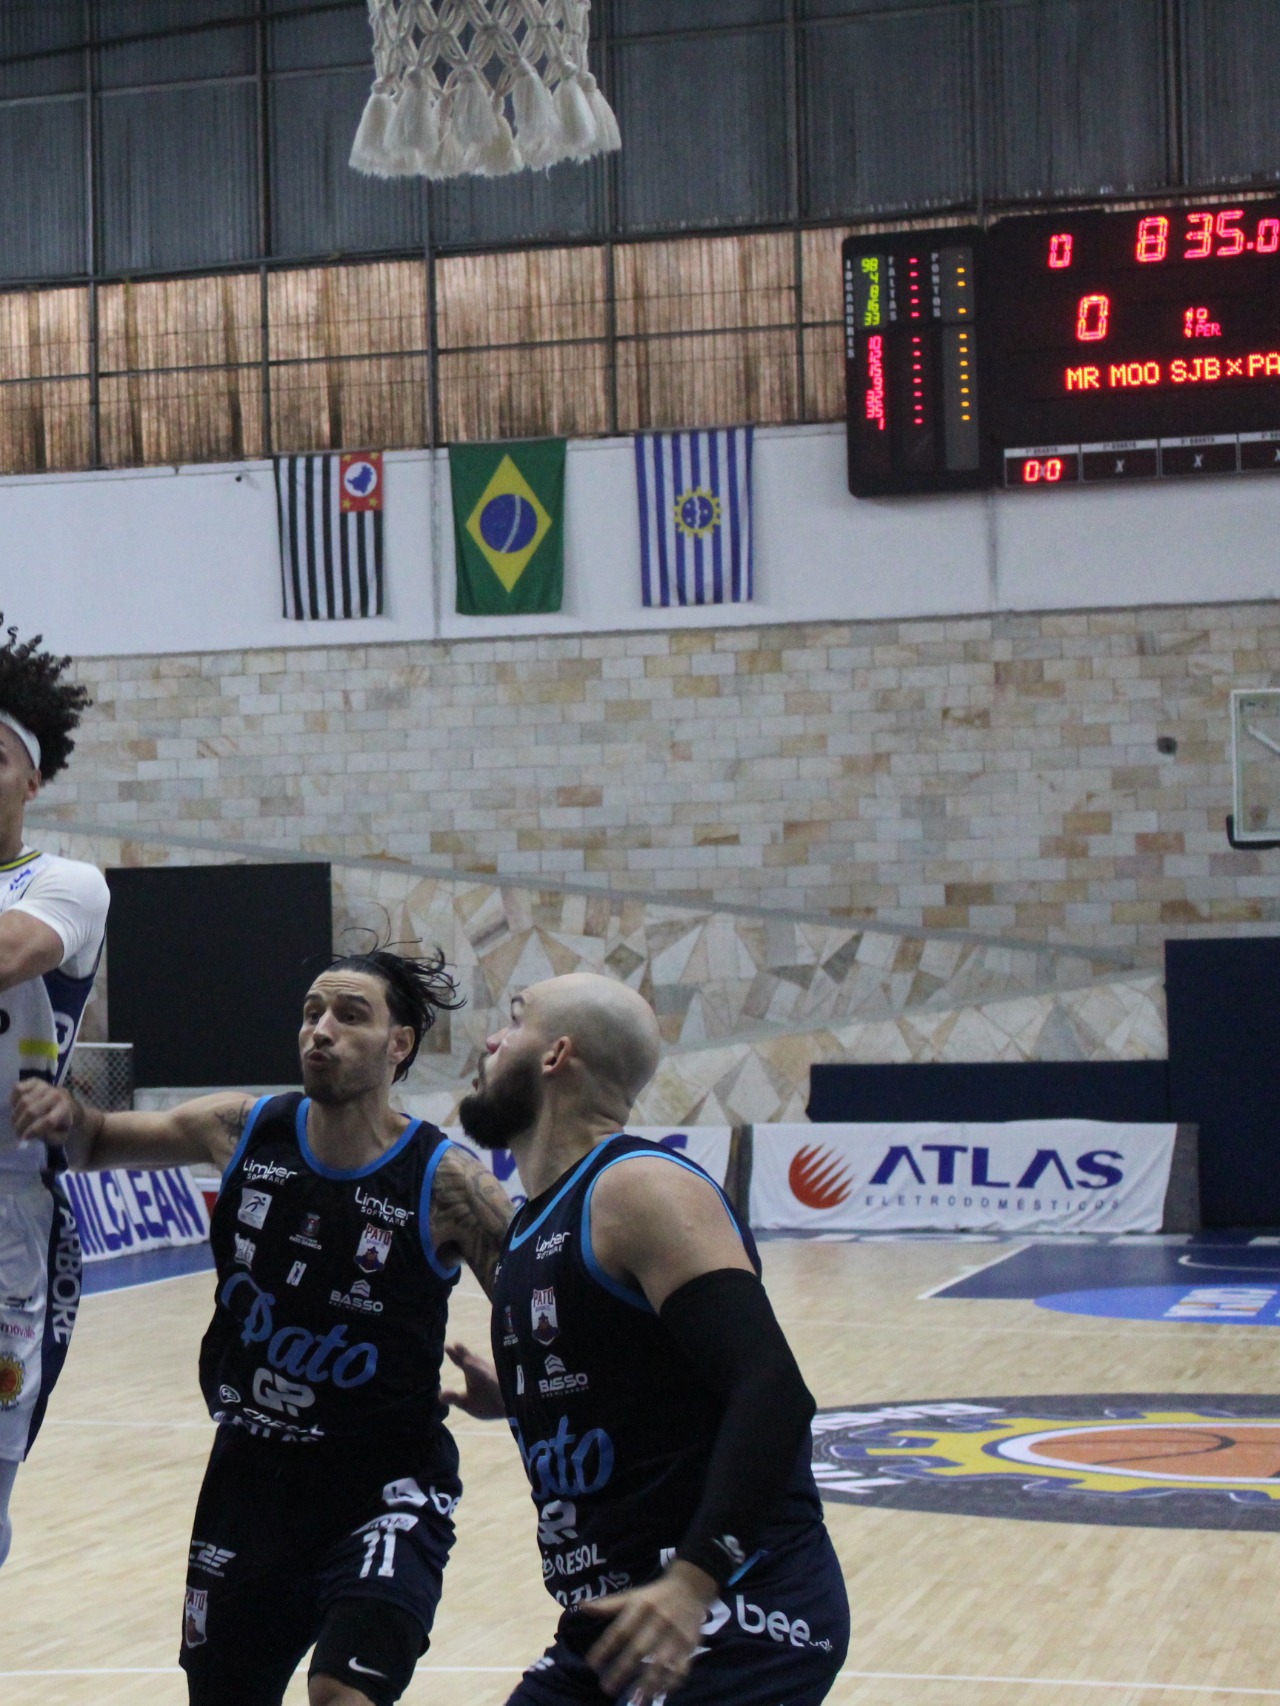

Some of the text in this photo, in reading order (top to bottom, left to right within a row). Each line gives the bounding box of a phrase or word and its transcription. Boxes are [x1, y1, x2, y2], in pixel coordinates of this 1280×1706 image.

[1048, 233, 1073, 268] 0
[931, 252, 941, 318] PONTOS
[1077, 294, 1109, 341] 0
[1065, 365, 1100, 391] MR
[1109, 361, 1160, 388] MOO
[1171, 357, 1221, 382] SJB
[243, 1156, 298, 1179] Limber
[868, 1144, 1125, 1190] ATLAS
[354, 1186, 415, 1220] Limber
[360, 1206, 406, 1227] SOFTWARE
[364, 1225, 393, 1247] PATO
[330, 1289, 384, 1312] BASSO
[532, 1286, 554, 1307] PATO
[219, 1270, 380, 1389] Pato
[359, 1527, 397, 1578] 71
[735, 1594, 811, 1648] bee
